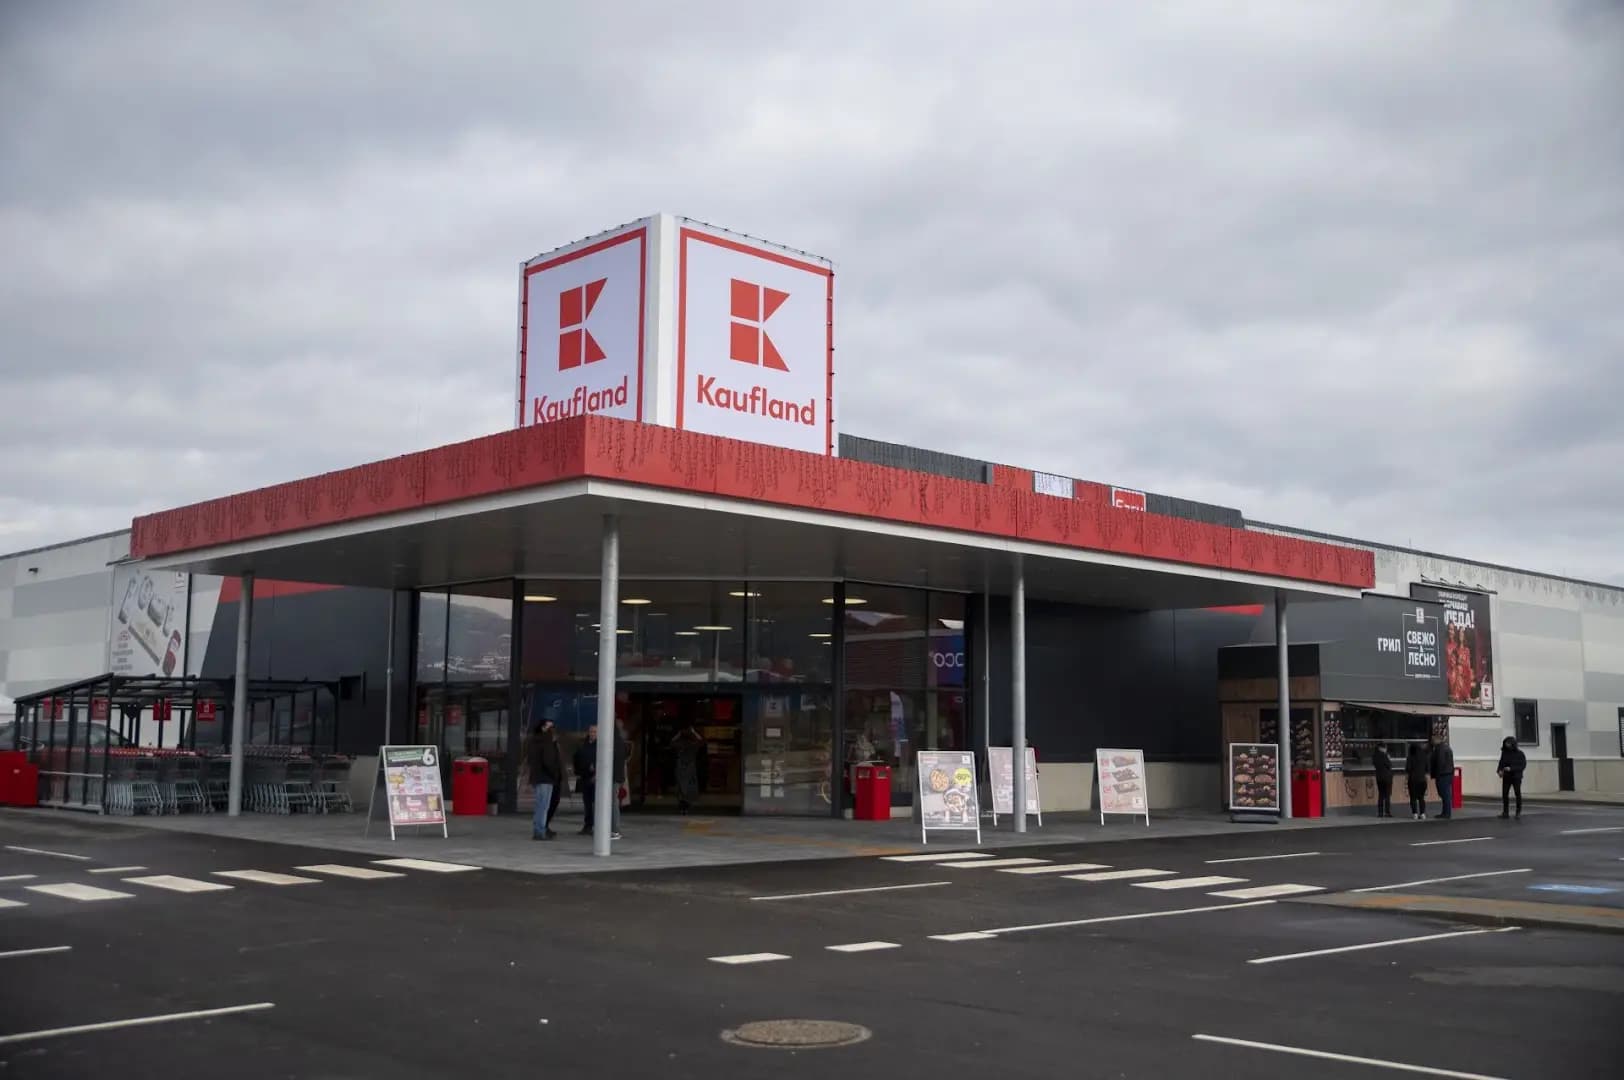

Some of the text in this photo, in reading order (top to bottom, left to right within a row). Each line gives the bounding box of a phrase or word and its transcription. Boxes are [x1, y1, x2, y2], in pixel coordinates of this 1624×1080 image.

[534, 375, 627, 424] Kaufland
[696, 374, 815, 426] Kaufland
[1377, 637, 1401, 652] ГРИЛ
[1406, 630, 1436, 647] СВЕЖО
[1408, 652, 1436, 667] ЛЕСНО
[423, 749, 435, 765] 6
